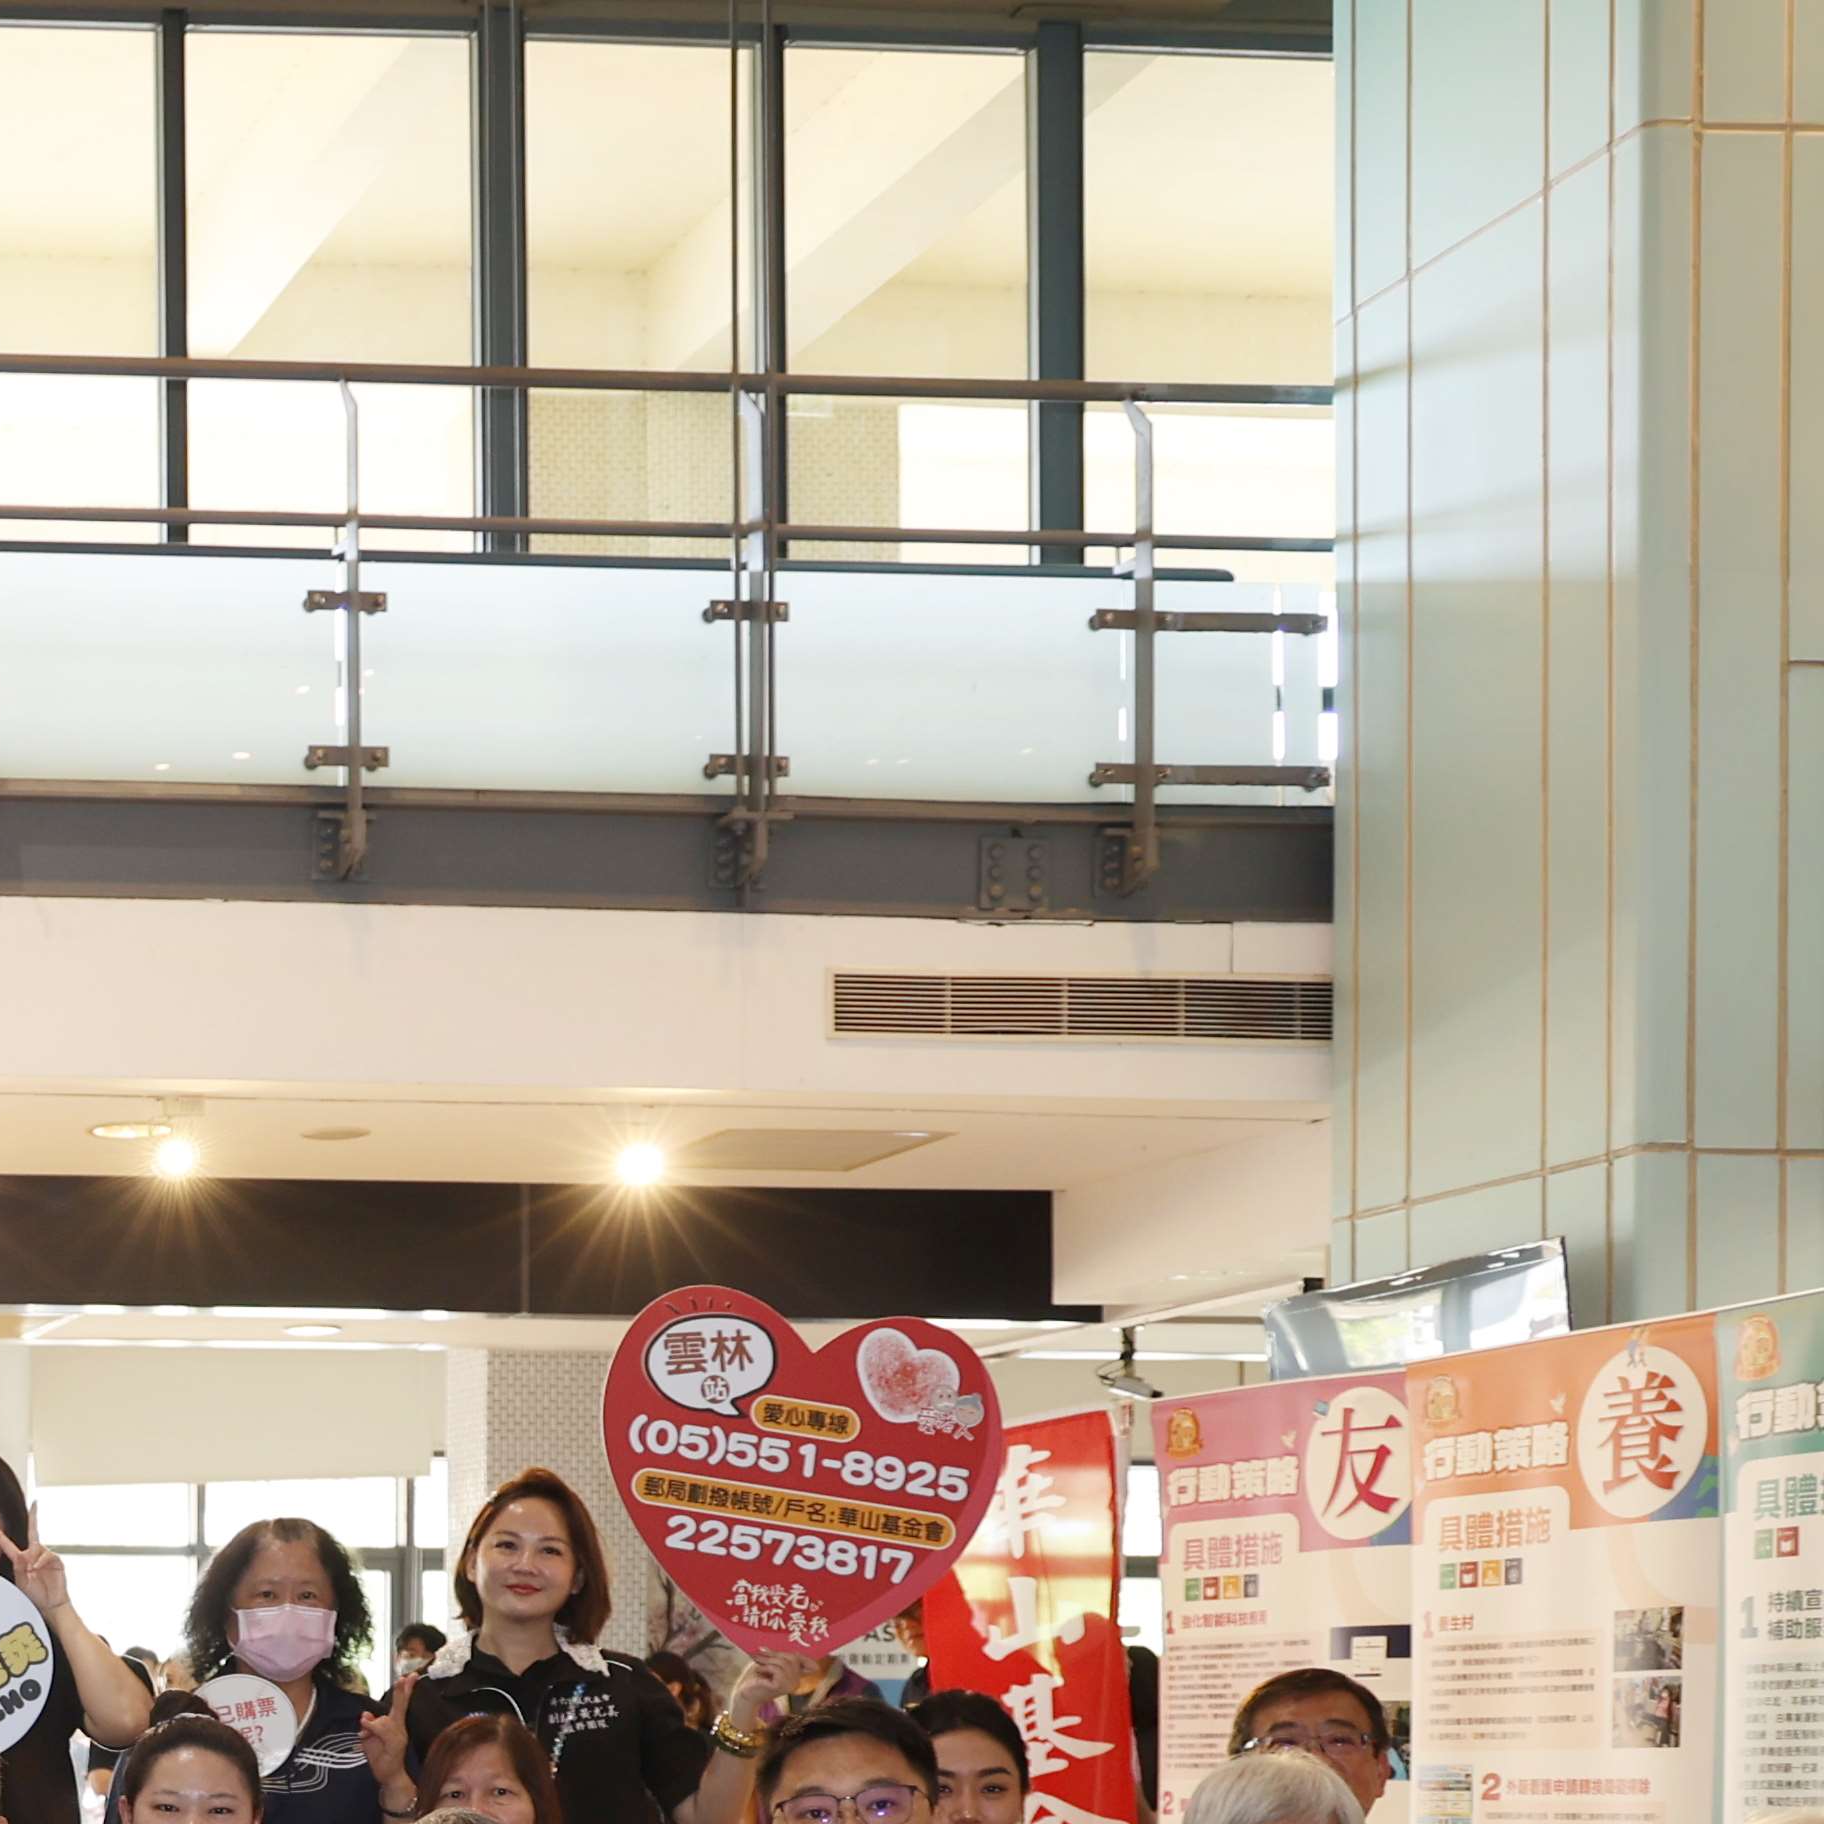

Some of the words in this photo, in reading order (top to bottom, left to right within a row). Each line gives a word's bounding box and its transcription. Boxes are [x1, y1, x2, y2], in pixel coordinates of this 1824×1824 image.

[663, 1329, 755, 1376] 雲林
[702, 1376, 730, 1404] 站
[762, 1402, 851, 1435] 愛心專線
[629, 1413, 971, 1502] (05)551-8925
[1319, 1405, 1400, 1518] 友
[1596, 1370, 1687, 1495] 養
[664, 1514, 914, 1585] 22573817
